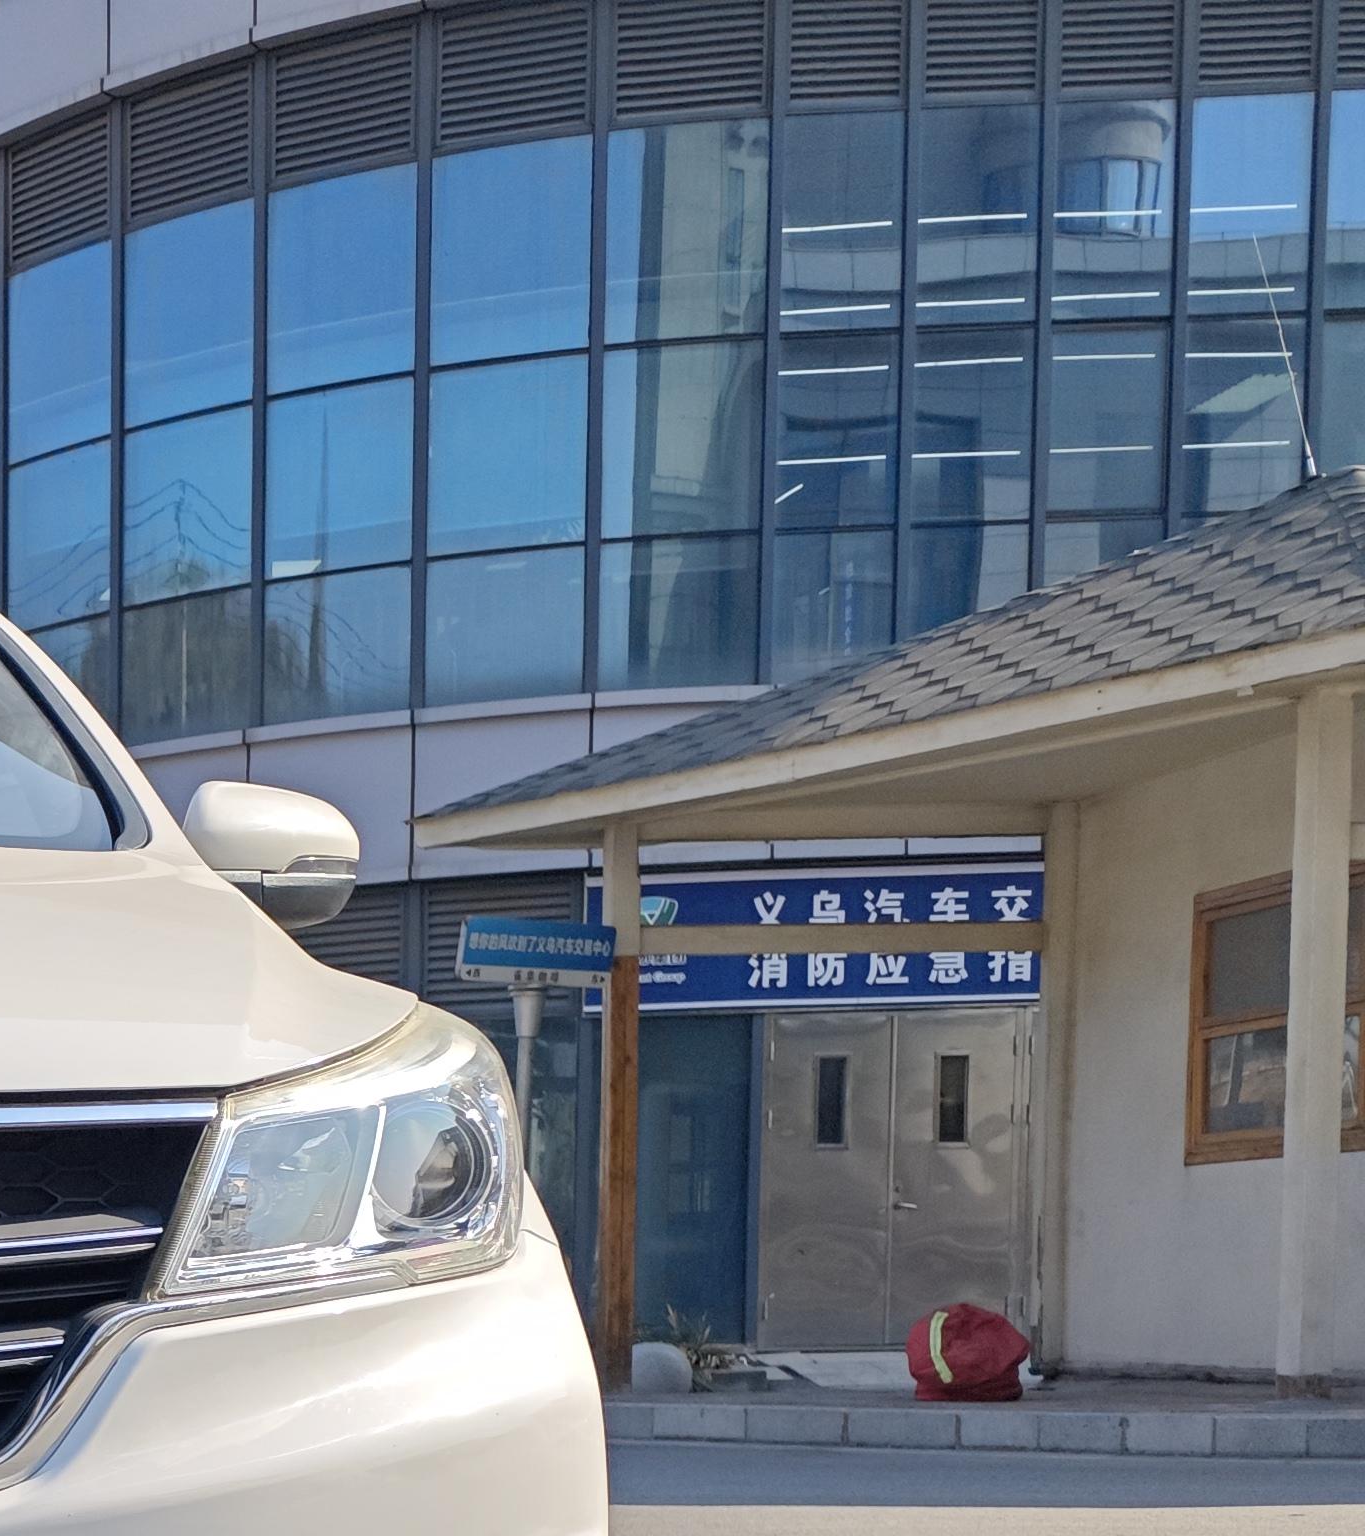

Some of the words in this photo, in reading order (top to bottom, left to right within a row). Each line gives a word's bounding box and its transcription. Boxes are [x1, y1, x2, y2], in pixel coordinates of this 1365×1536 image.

[748, 951, 1032, 988] 消防应急指
